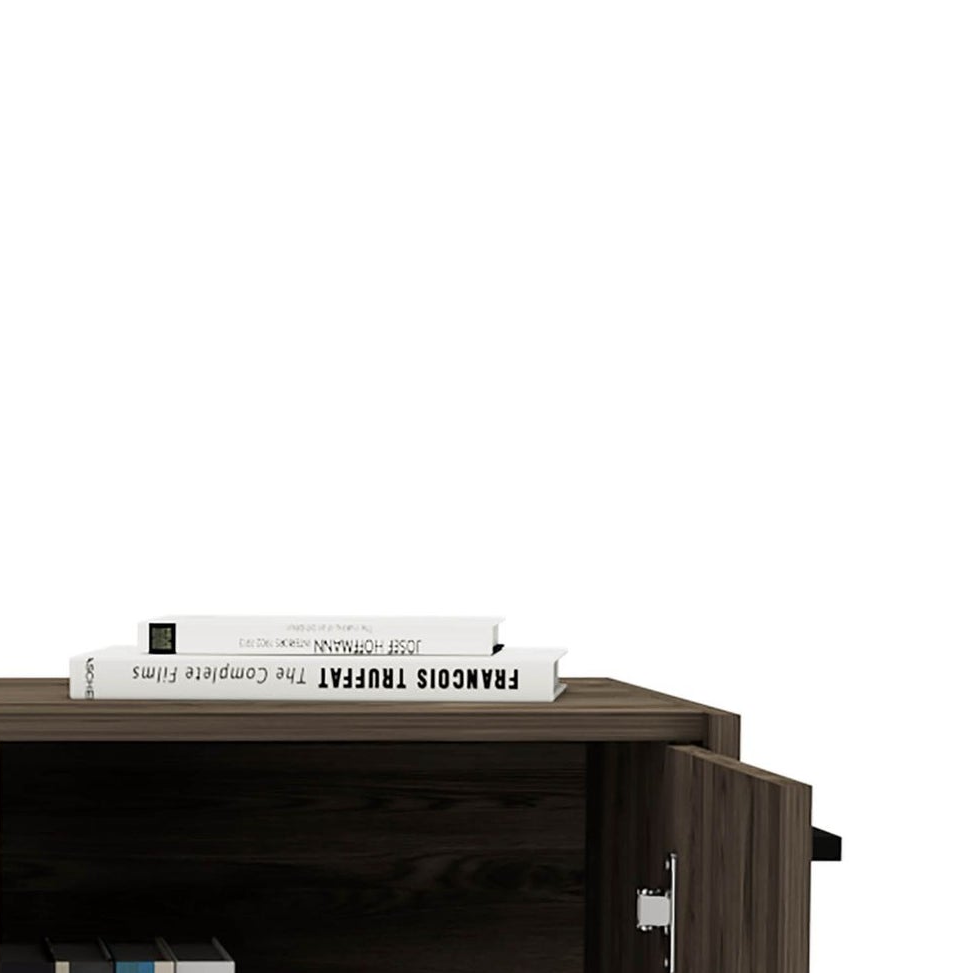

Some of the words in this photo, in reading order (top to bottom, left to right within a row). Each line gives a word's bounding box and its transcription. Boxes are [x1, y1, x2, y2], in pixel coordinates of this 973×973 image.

[314, 639, 384, 654] HOFFMANN
[388, 639, 422, 654] JOSEF
[132, 665, 178, 684] Films
[185, 663, 269, 684] Complete
[276, 667, 307, 685] The
[318, 667, 407, 689] TRUFFAT
[417, 668, 519, 690] FRANCOIS
